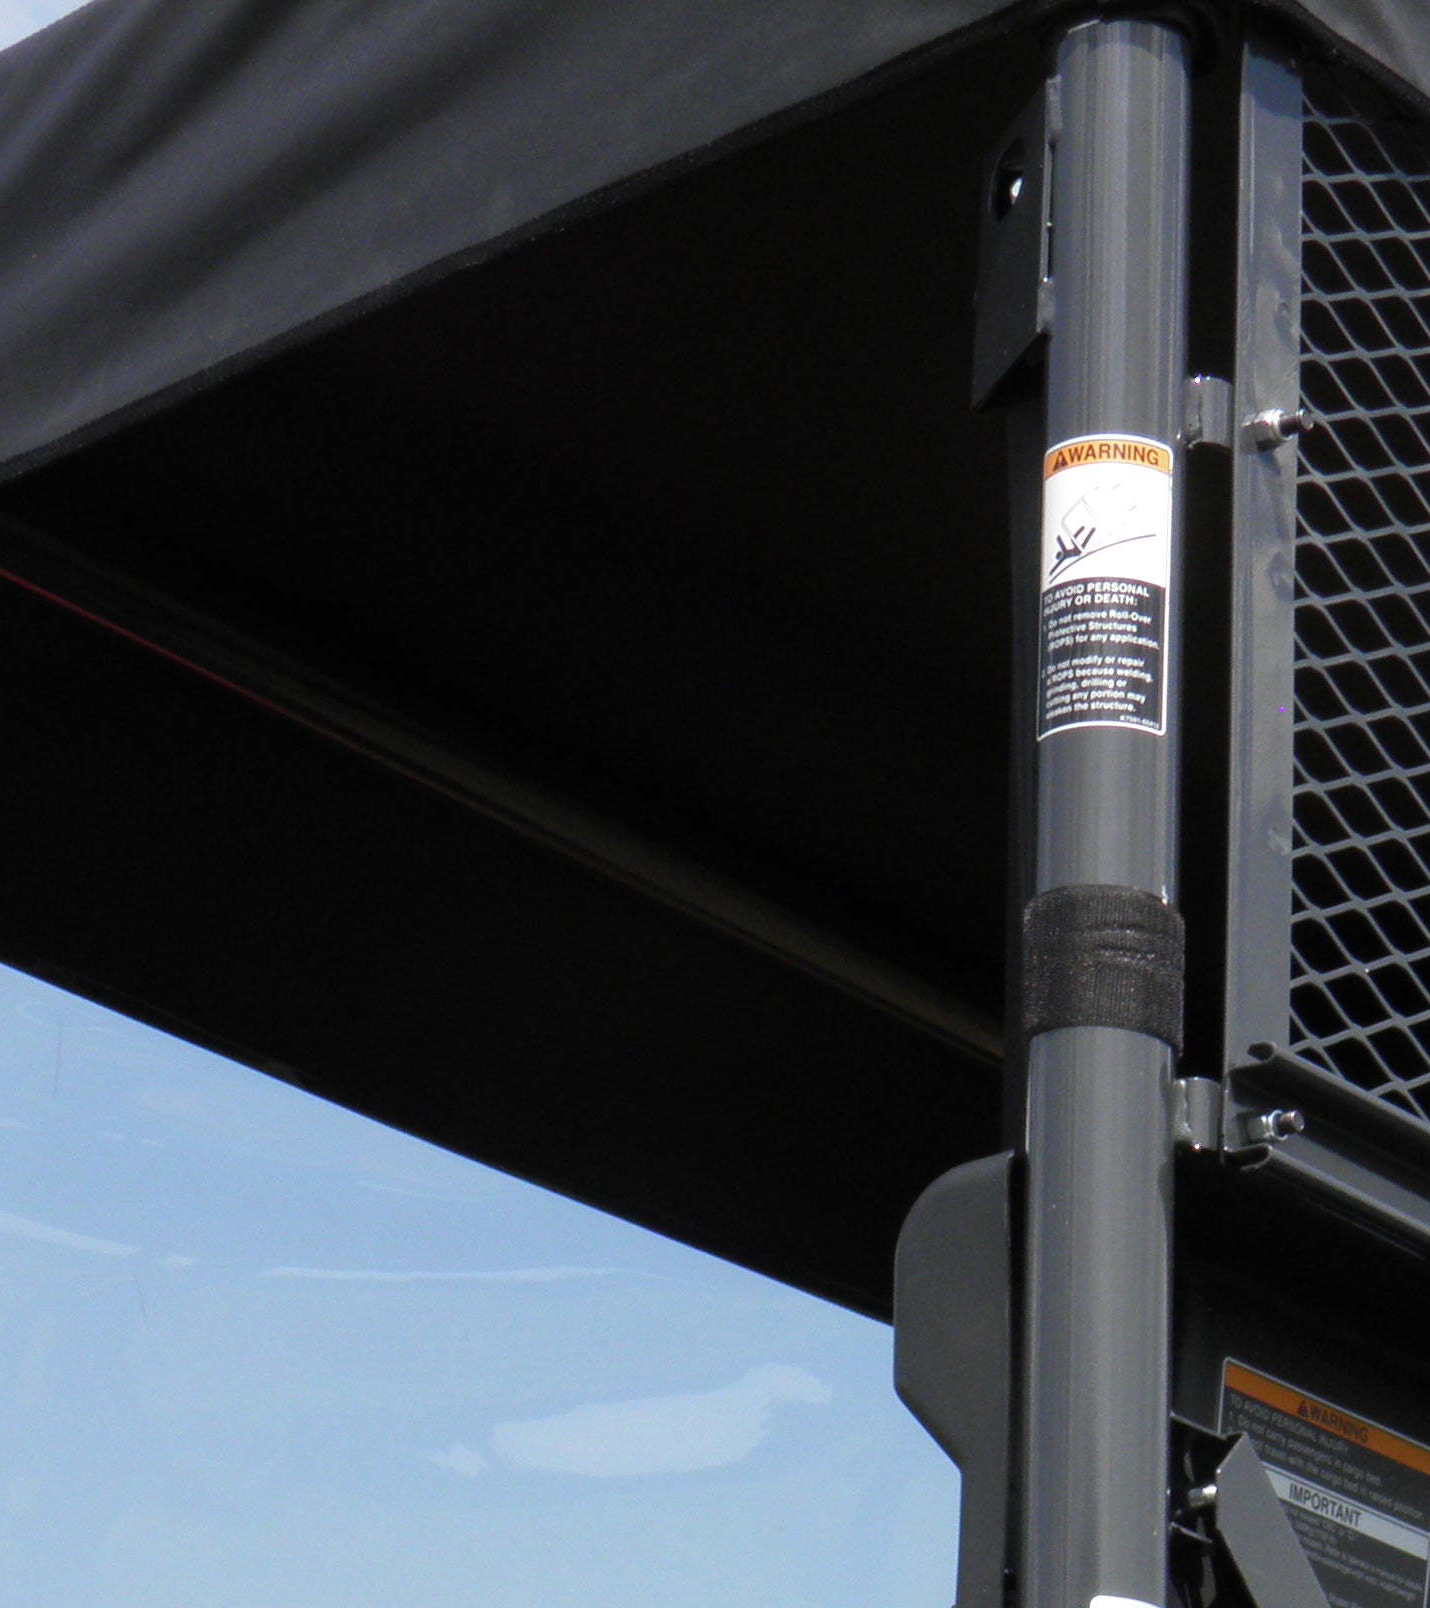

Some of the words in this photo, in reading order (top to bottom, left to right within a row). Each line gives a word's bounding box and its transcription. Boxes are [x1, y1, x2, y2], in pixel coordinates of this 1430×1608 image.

[1068, 442, 1159, 467] WARNING
[1054, 584, 1085, 600] AVOID
[1087, 582, 1150, 597] PERSONAL
[1074, 594, 1092, 606] OR
[1094, 594, 1138, 606] DEATH:
[1073, 611, 1107, 622] remove
[1109, 609, 1153, 625] Roll-Over
[1088, 621, 1138, 633] Structures
[1075, 633, 1089, 644] for
[1090, 633, 1108, 646] any
[1071, 654, 1104, 667] modify
[1104, 655, 1116, 665] or
[1075, 666, 1116, 678] because
[1080, 678, 1116, 690] drilling
[1116, 679, 1128, 688] or
[1072, 691, 1090, 702] any
[1090, 690, 1126, 701] portion
[1126, 692, 1148, 705] may
[1308, 1403, 1370, 1445] WARNING
[1289, 1483, 1362, 1526] IMPORTANT
